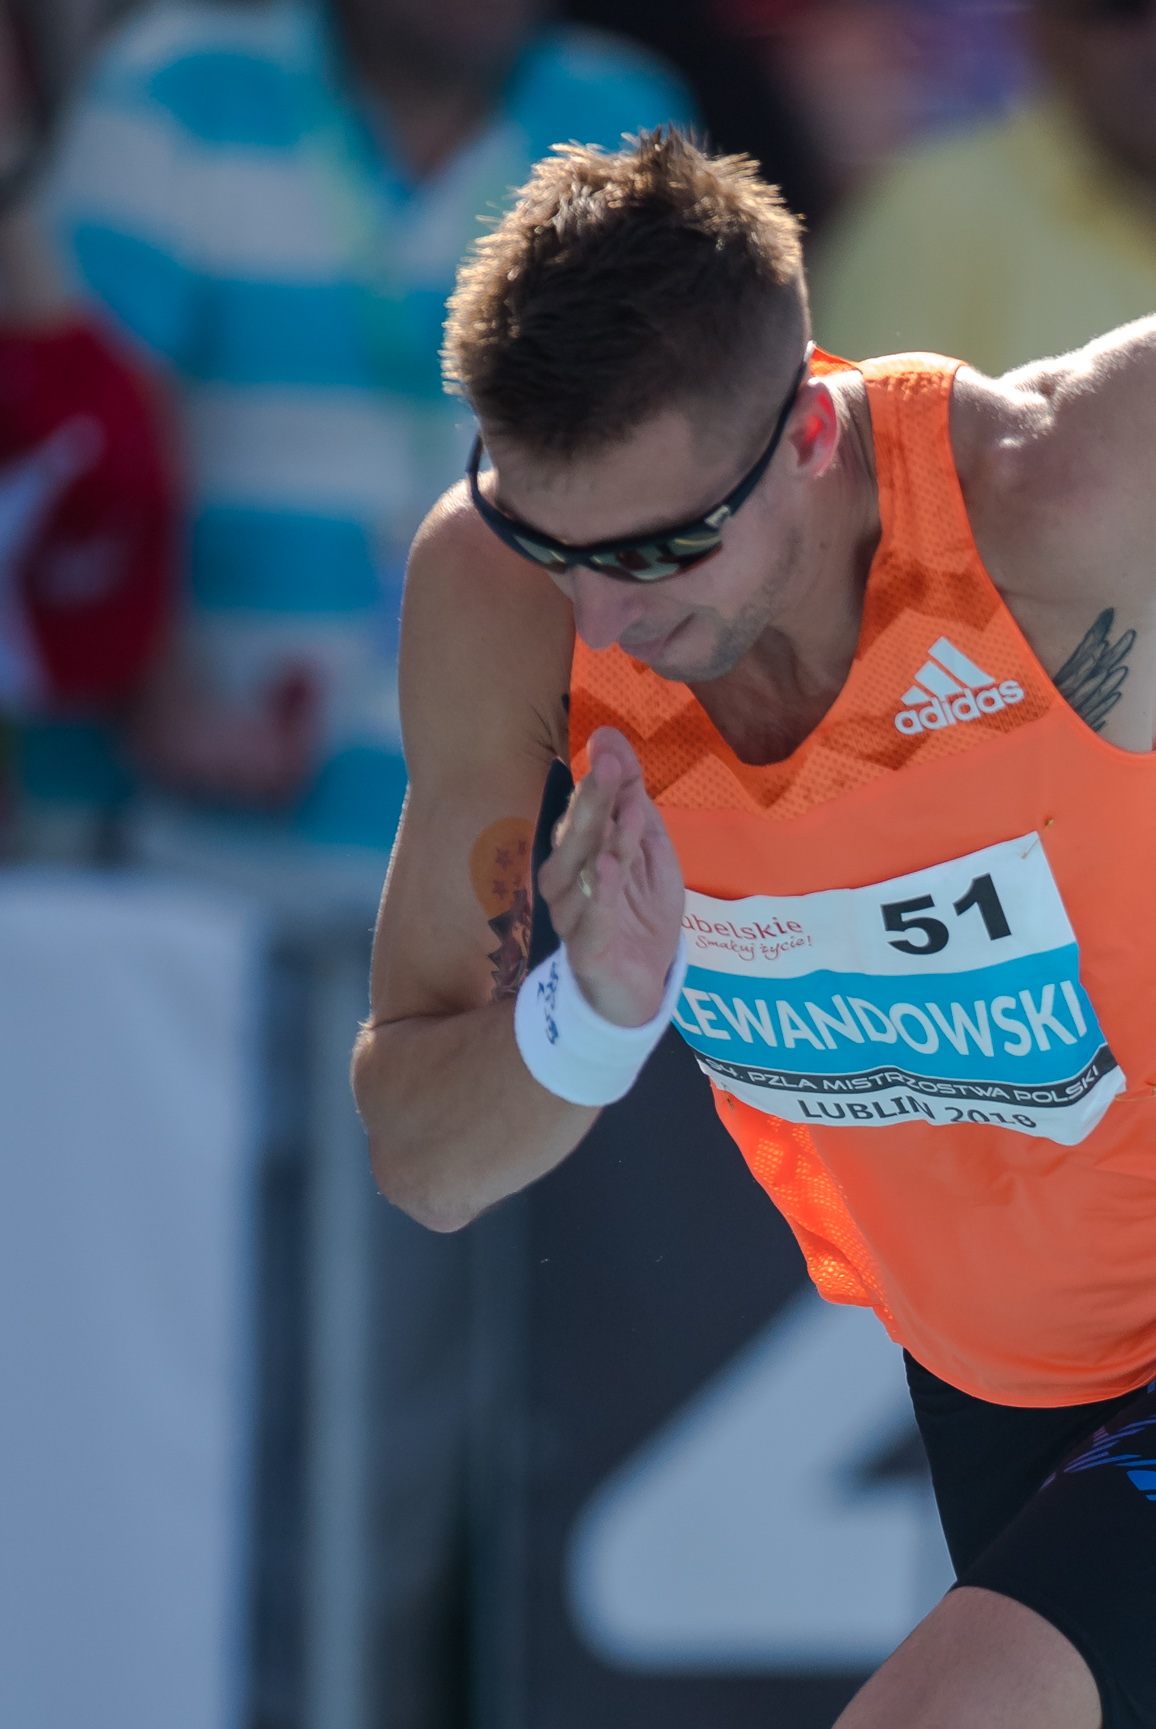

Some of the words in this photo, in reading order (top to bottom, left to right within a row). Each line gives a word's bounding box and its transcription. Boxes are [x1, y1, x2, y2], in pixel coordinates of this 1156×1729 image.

[894, 679, 1025, 735] adidas
[681, 913, 803, 940] ubelskie
[880, 872, 1012, 955] 51
[695, 935, 754, 961] Smakuj
[747, 1071, 817, 1089] PZLA
[823, 1071, 1010, 1100] MISTRZOSTWA
[1013, 1065, 1099, 1103] POLSKI
[797, 1095, 937, 1120] LUBLIN
